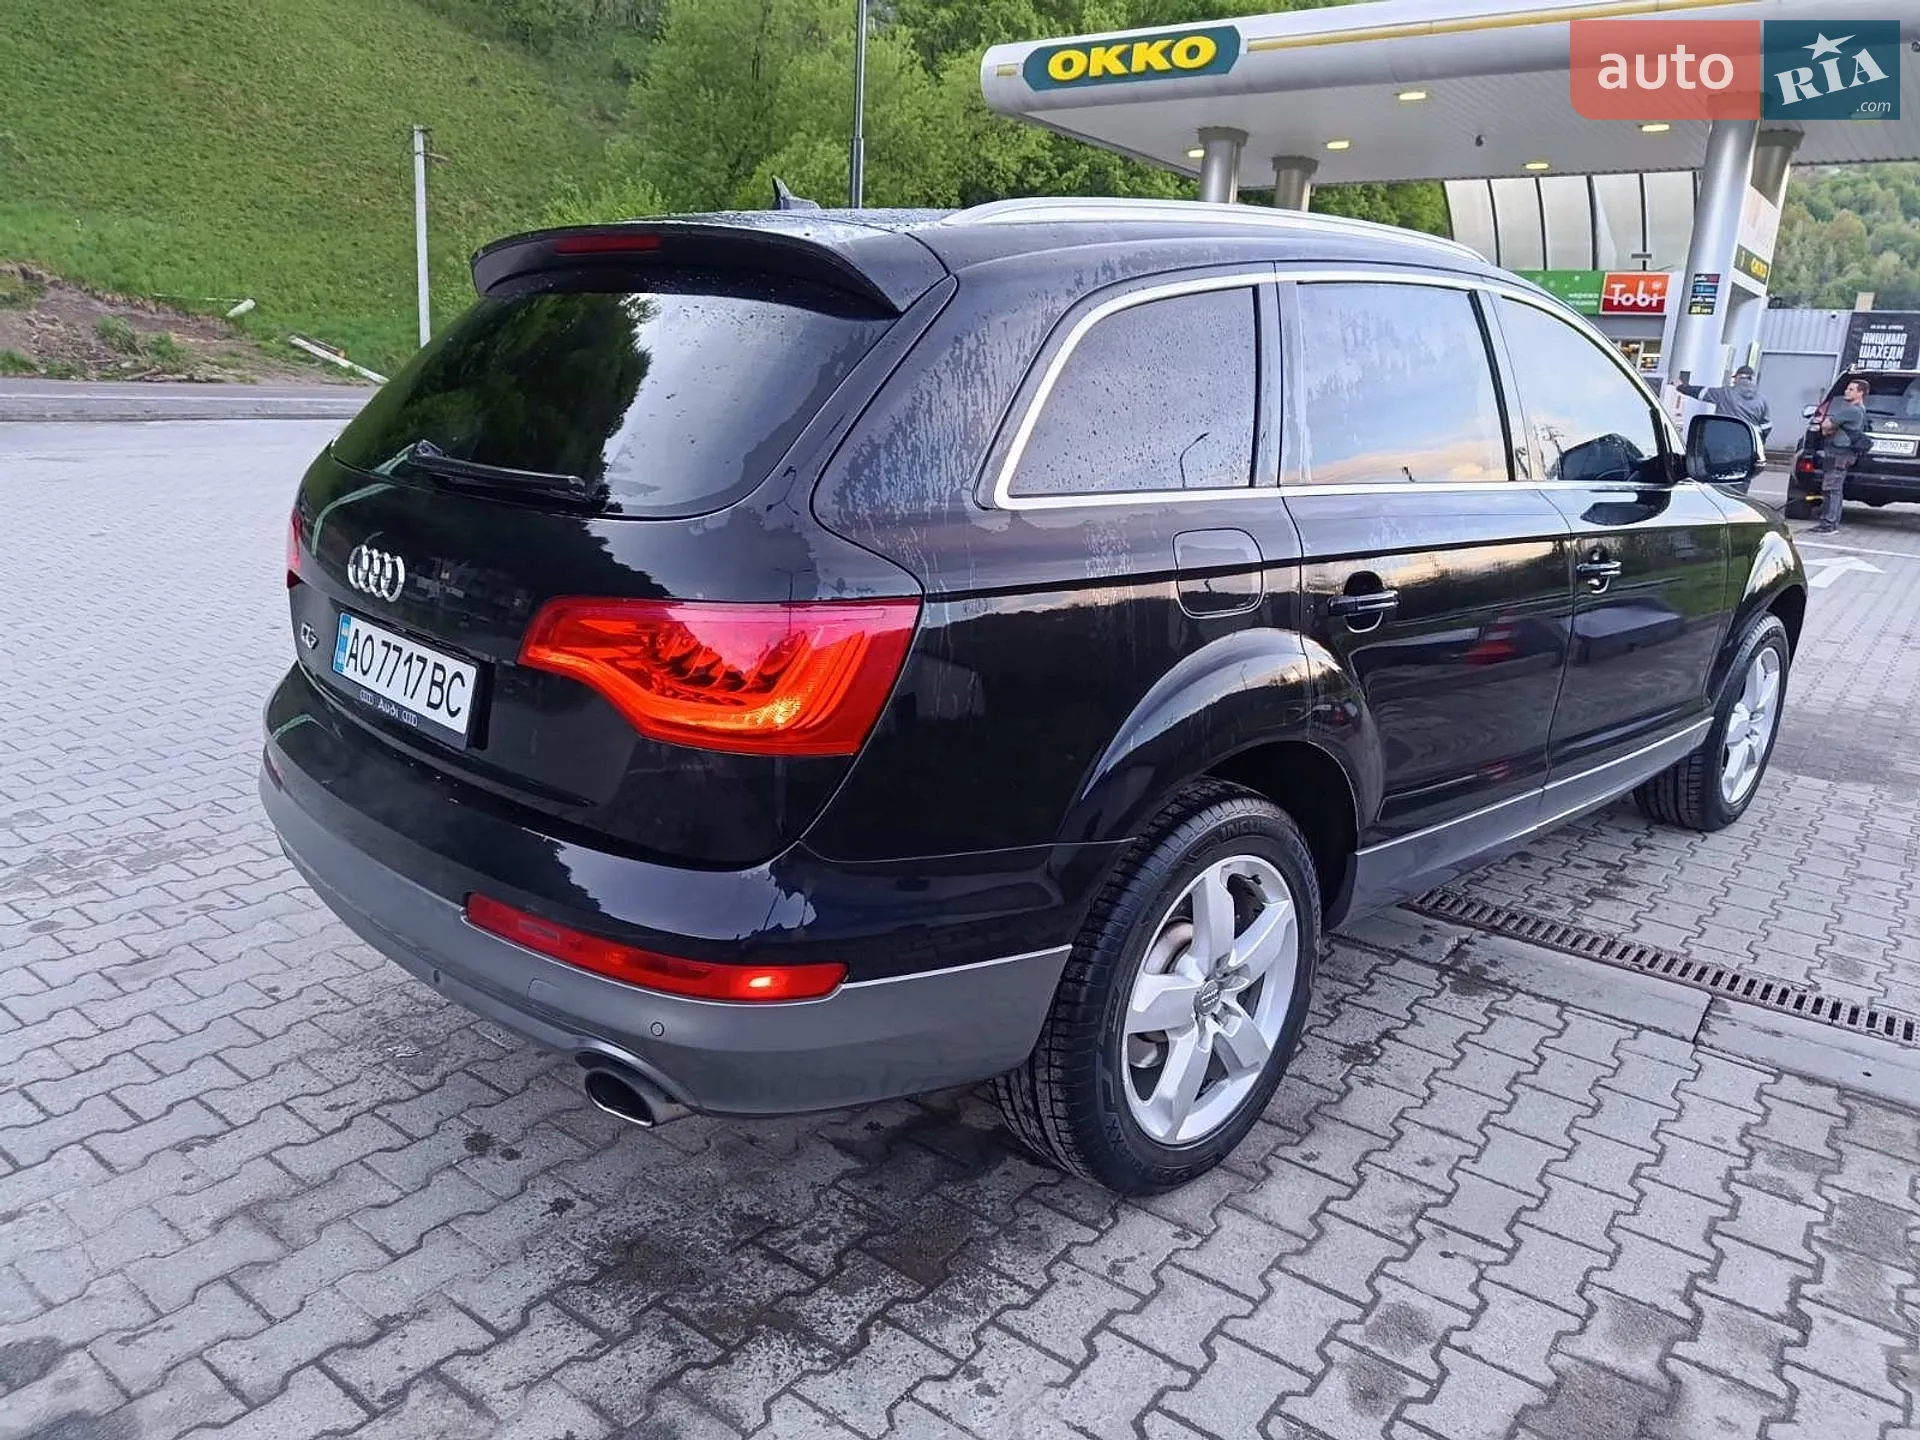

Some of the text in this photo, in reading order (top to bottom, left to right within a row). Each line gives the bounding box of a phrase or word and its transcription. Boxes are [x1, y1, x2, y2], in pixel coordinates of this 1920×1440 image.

[1046, 35, 1217, 82] OKKO
[1610, 280, 1660, 308] Tobi
[346, 628, 465, 718] AO 7717 BC
